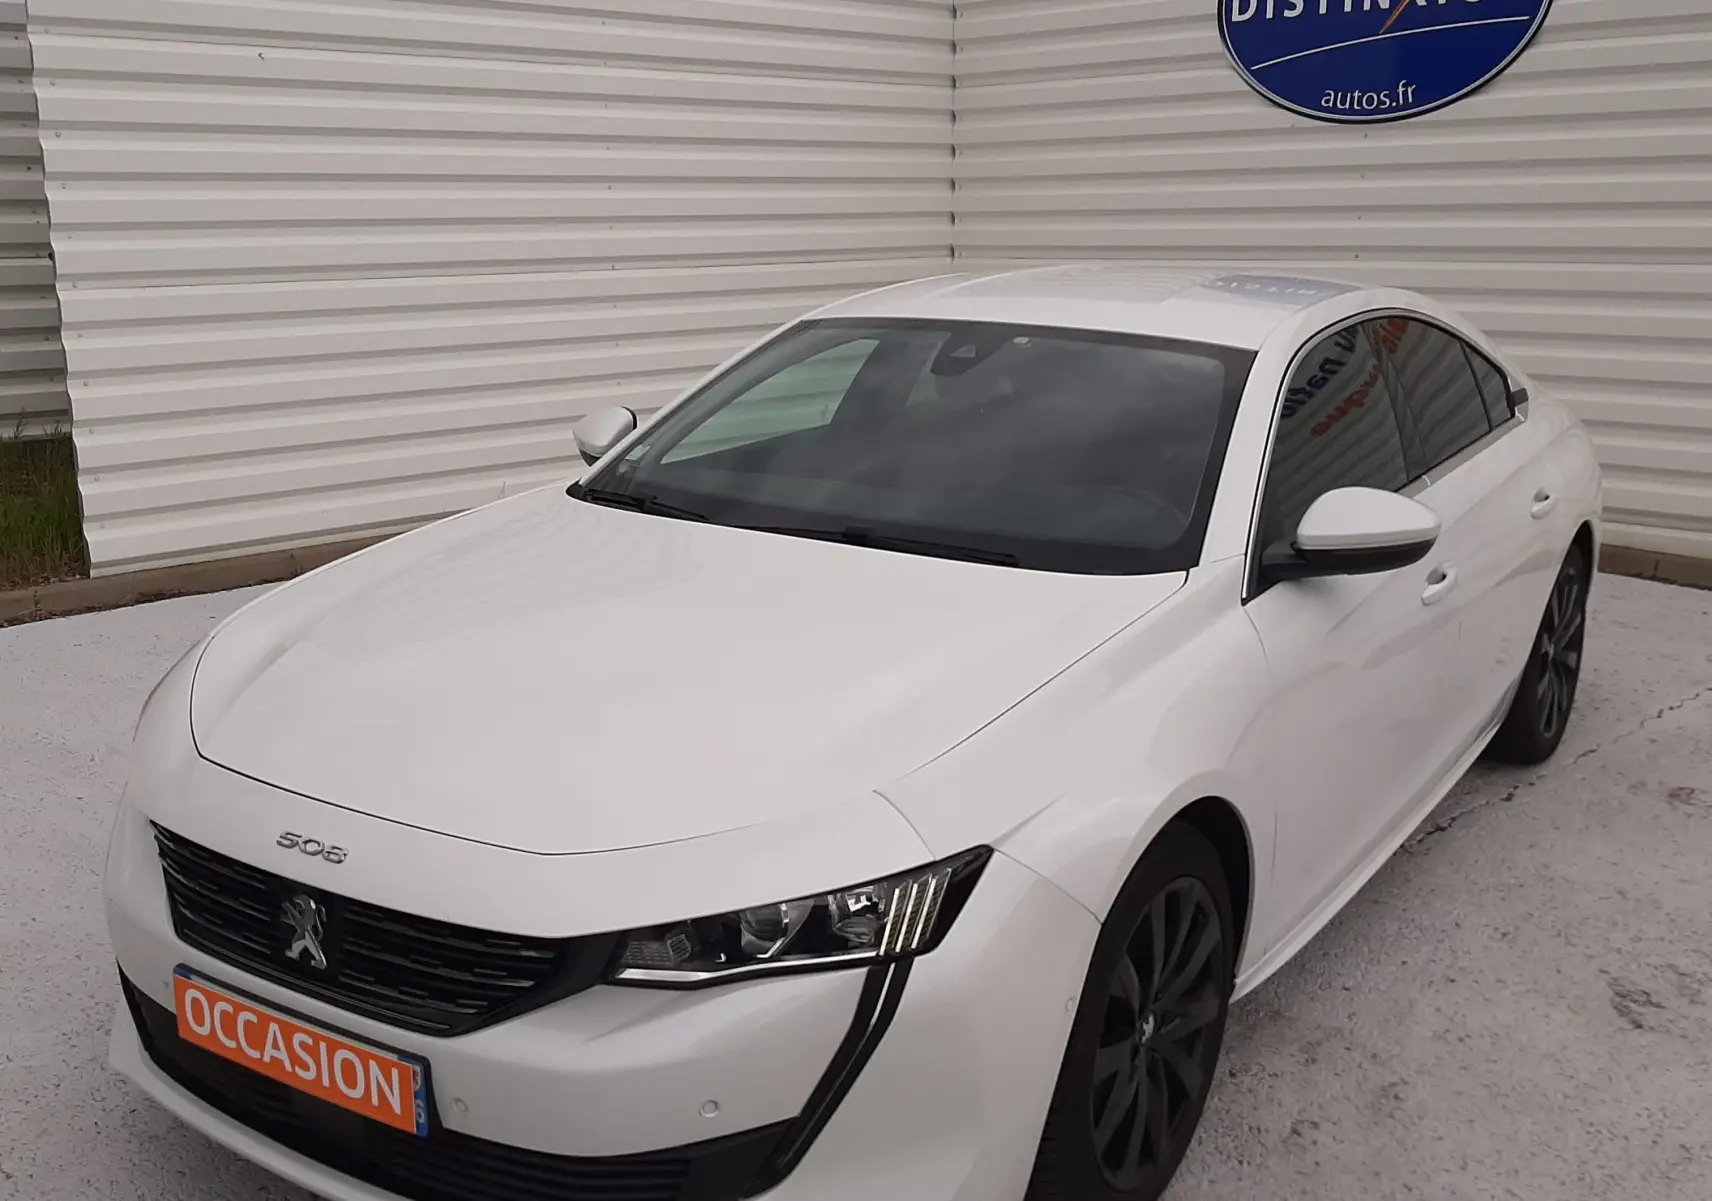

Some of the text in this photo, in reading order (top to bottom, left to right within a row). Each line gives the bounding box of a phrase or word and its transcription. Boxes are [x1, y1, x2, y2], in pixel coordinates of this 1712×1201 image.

[1321, 80, 1417, 110] autos.fr
[276, 830, 350, 865] 508
[184, 988, 401, 1116] OCCASION
